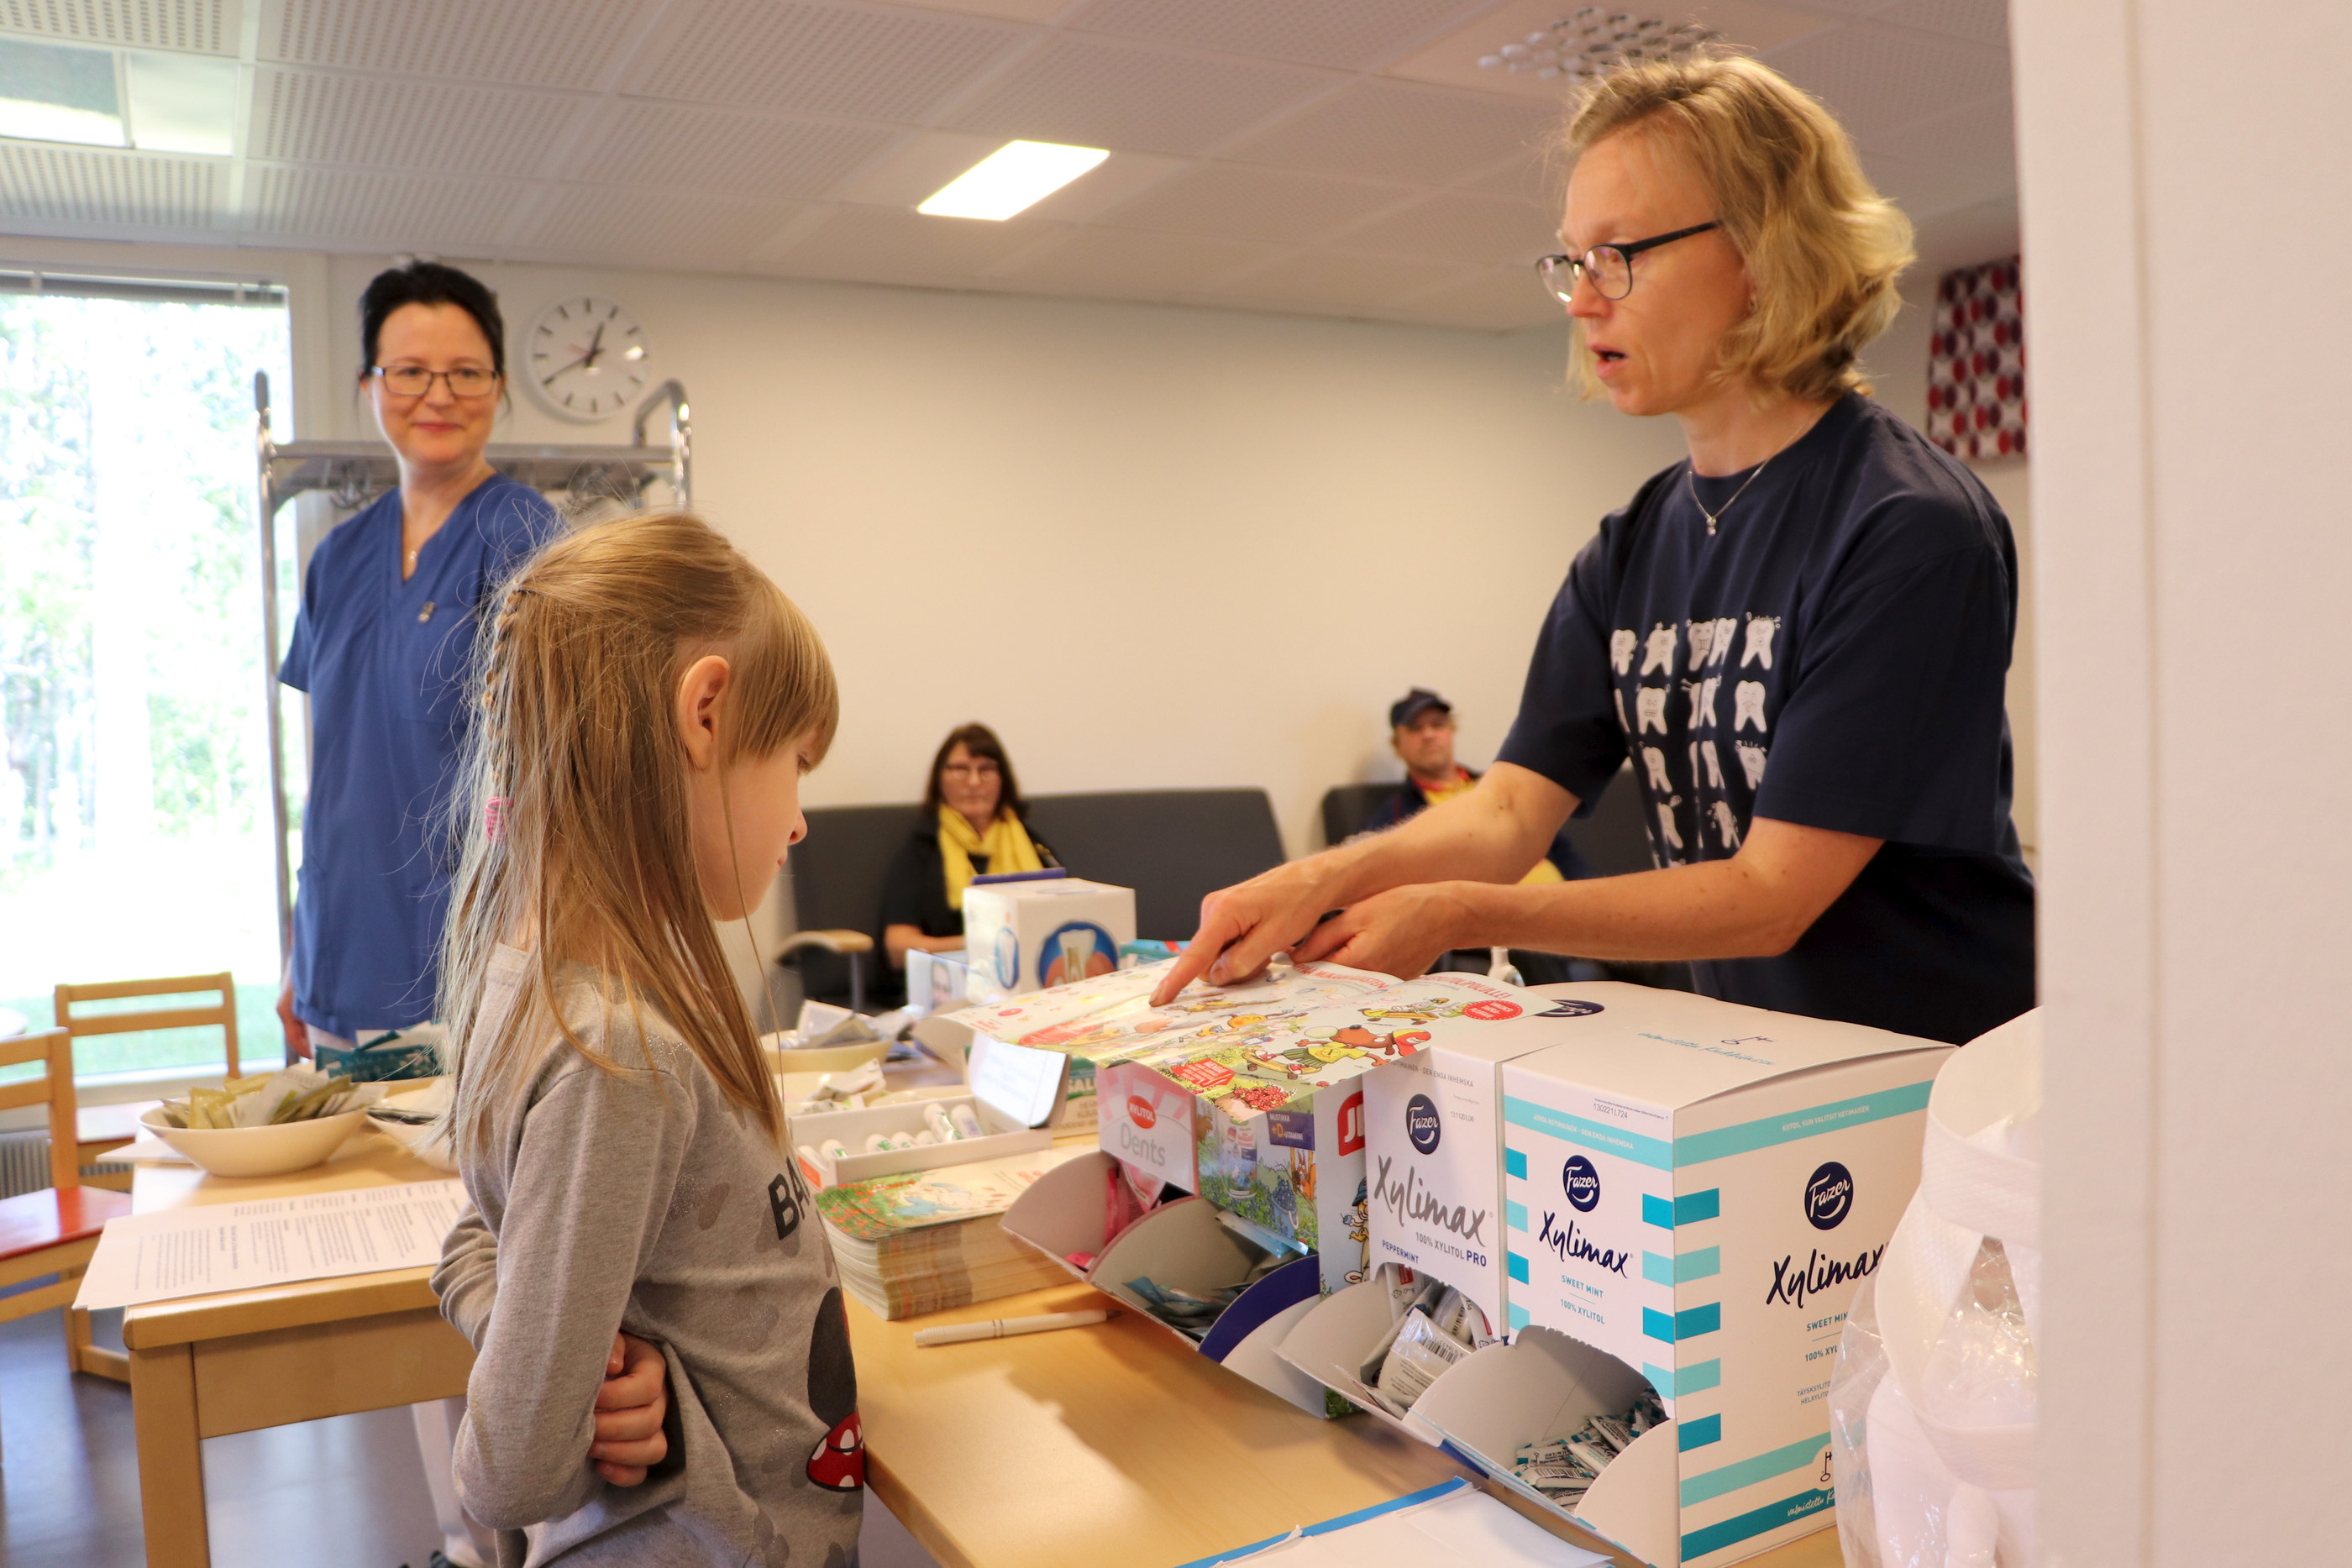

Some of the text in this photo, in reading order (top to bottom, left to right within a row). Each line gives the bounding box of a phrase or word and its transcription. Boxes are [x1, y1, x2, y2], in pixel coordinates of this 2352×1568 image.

[1423, 1067, 1432, 1076] DEN
[1433, 1070, 1446, 1080] ENDA
[1447, 1073, 1474, 1088] INHEMSKA
[1128, 1102, 1155, 1123] XYLITOL
[1410, 1105, 1439, 1135] Fazer
[1593, 1104, 1628, 1119] 130221L724
[1782, 1105, 1870, 1132] KIITOS, KUN VALITSIT KOTIMAISEN
[1121, 1122, 1166, 1167] Dents
[1581, 1128, 1592, 1137] DEN
[1606, 1135, 1634, 1149] INHEMSKA
[1566, 1165, 1598, 1193] Fazer
[768, 1156, 811, 1240] BA
[1373, 1155, 1487, 1248] Xylimax
[1809, 1173, 1851, 1218] Fazer
[1382, 1240, 1420, 1264] PEPPERMINT
[1415, 1232, 1487, 1267] 100% XYLITOL PRO
[1539, 1210, 1628, 1279] Xylimax
[1562, 1275, 1604, 1298] SWEET MINT
[1766, 1244, 1884, 1308] Xylimax
[1561, 1298, 1605, 1324] 100% XYLITOL
[1806, 1311, 1848, 1332] SWEET MIN
[1805, 1345, 1838, 1361] 100% XYL
[1797, 1381, 1831, 1397] TÄYSKSYLITO
[1800, 1391, 1829, 1404] HELXYLITO
